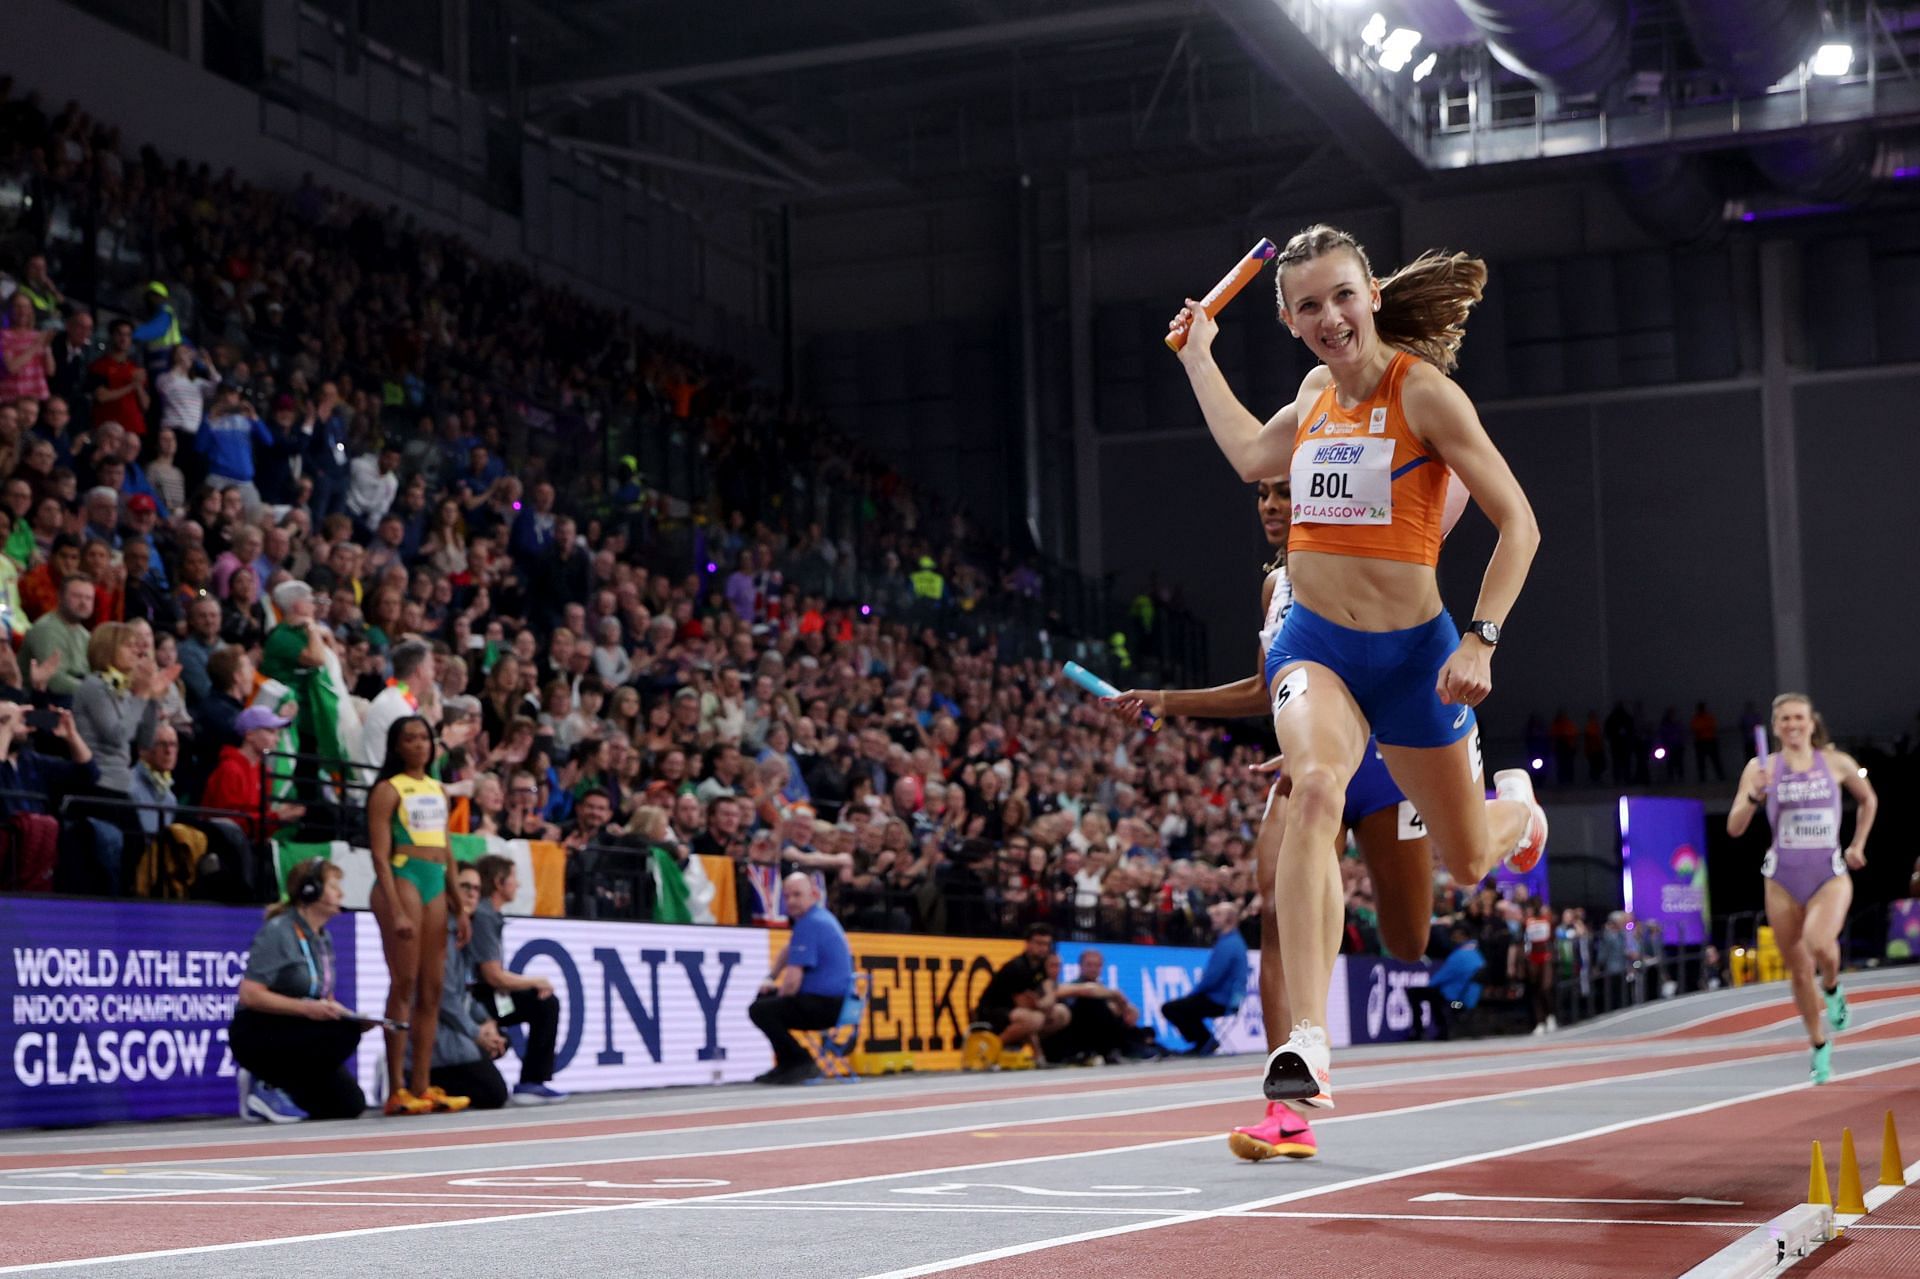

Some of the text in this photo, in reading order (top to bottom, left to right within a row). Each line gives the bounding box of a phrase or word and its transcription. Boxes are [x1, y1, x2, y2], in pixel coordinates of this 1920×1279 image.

[1310, 472, 1354, 499] BOL
[1303, 504, 1386, 519] GLASGOW 24
[1278, 684, 1291, 710] 5
[1409, 812, 1423, 832] 4
[13, 947, 119, 988] WORLD
[13, 993, 239, 1025] INDOOR CHAMPIONSHI
[505, 937, 742, 1075] ONY
[843, 955, 995, 1054] EIK
[13, 1028, 238, 1088] GLASGOW 2
